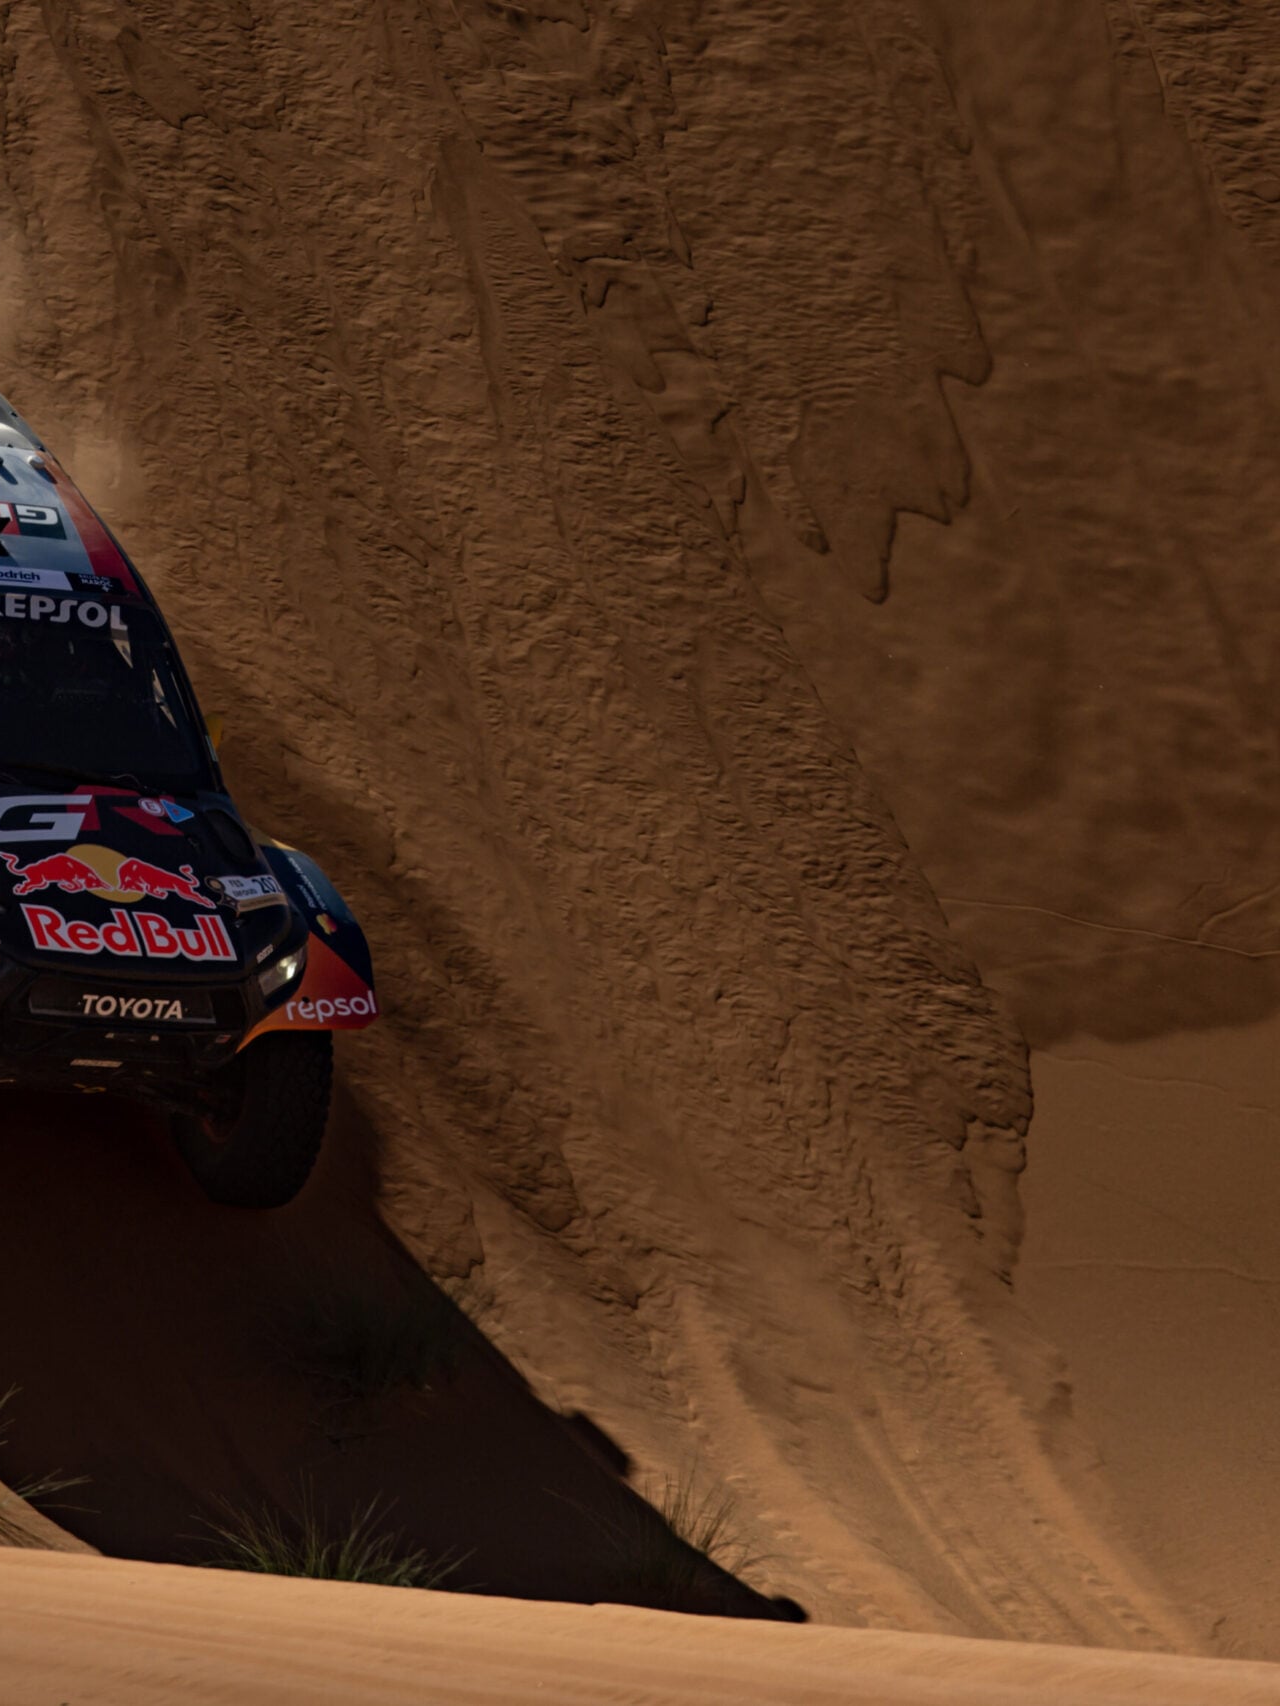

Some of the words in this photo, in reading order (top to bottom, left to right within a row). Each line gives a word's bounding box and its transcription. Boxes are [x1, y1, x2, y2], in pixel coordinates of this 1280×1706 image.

[20, 903, 142, 956] Red
[132, 911, 238, 961] Bull
[81, 993, 183, 1020] TOYOTA
[285, 989, 377, 1023] repsol
